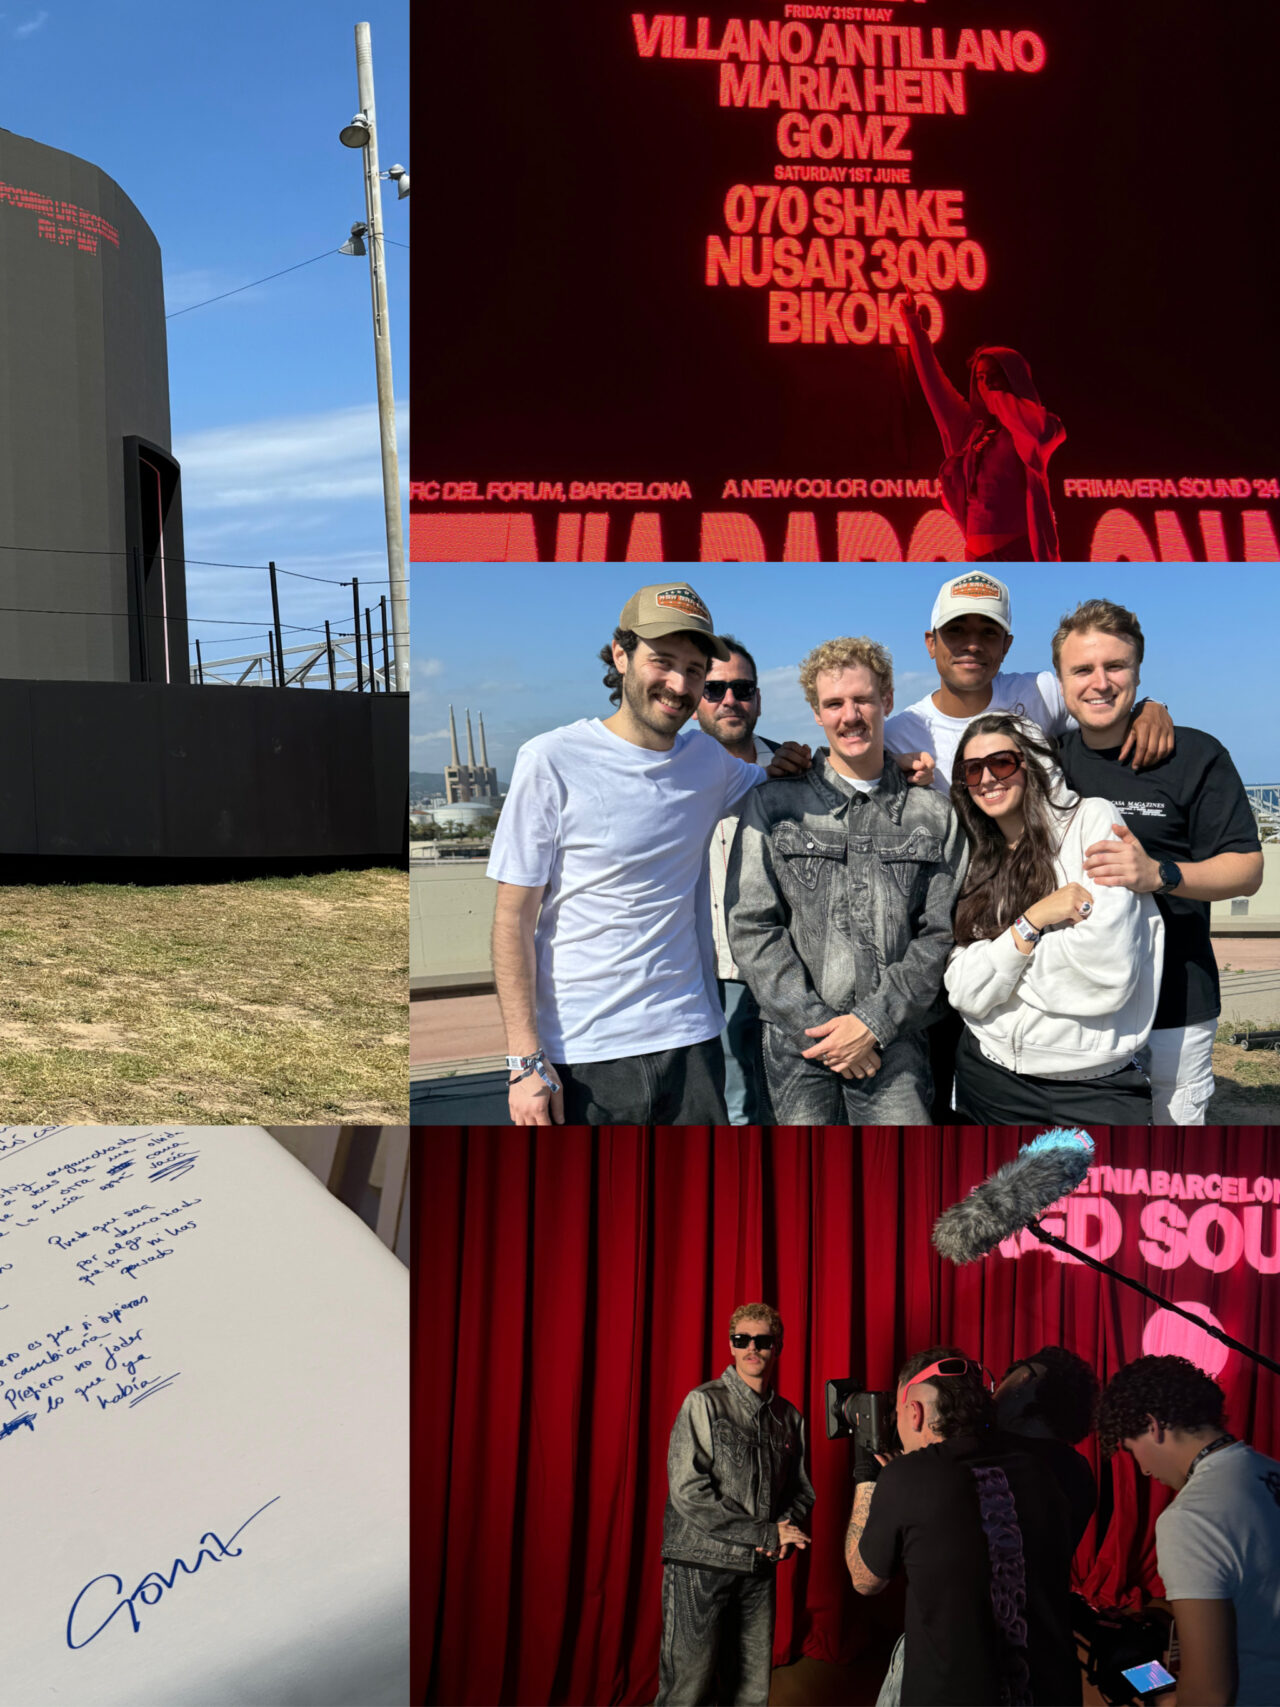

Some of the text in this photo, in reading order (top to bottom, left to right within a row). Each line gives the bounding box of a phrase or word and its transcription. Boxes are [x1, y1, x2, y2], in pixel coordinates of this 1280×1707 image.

[785, 4, 893, 22] FRIDAY 31ST MAY
[631, 13, 1046, 74] VILLANO ANTILLANO
[719, 62, 966, 116] MARIA HEIN
[776, 112, 912, 161] GOMZ
[774, 164, 911, 184] SATURDAY 1ST JUNE
[55, 200, 78, 227] LIVE
[723, 183, 967, 238] 070 SHAKE
[38, 218, 56, 243] FRI
[77, 231, 98, 257] MAY
[706, 234, 987, 291] NUSAR 3000
[441, 480, 484, 500] DEL
[485, 480, 566, 503] FORUM,
[568, 480, 692, 501] BARCELONA
[722, 479, 740, 498] A
[741, 478, 792, 498] NEW
[793, 478, 868, 498] COLOR
[870, 478, 902, 498] ON
[1063, 478, 1177, 498] PRIMAVERA
[1178, 477, 1251, 498] SOUND
[145, 1141, 190, 1160] cama
[92, 1217, 120, 1234] que
[123, 1203, 157, 1217] sea
[76, 1235, 143, 1272] por algo
[78, 1268, 105, 1286] que
[164, 1220, 198, 1237] has
[27, 1339, 43, 1351] es
[46, 1325, 74, 1347] que
[13, 1332, 113, 1380] cambiaría
[74, 1359, 93, 1372] no
[46, 1353, 152, 1414] lo que ya
[97, 1375, 162, 1410] había
